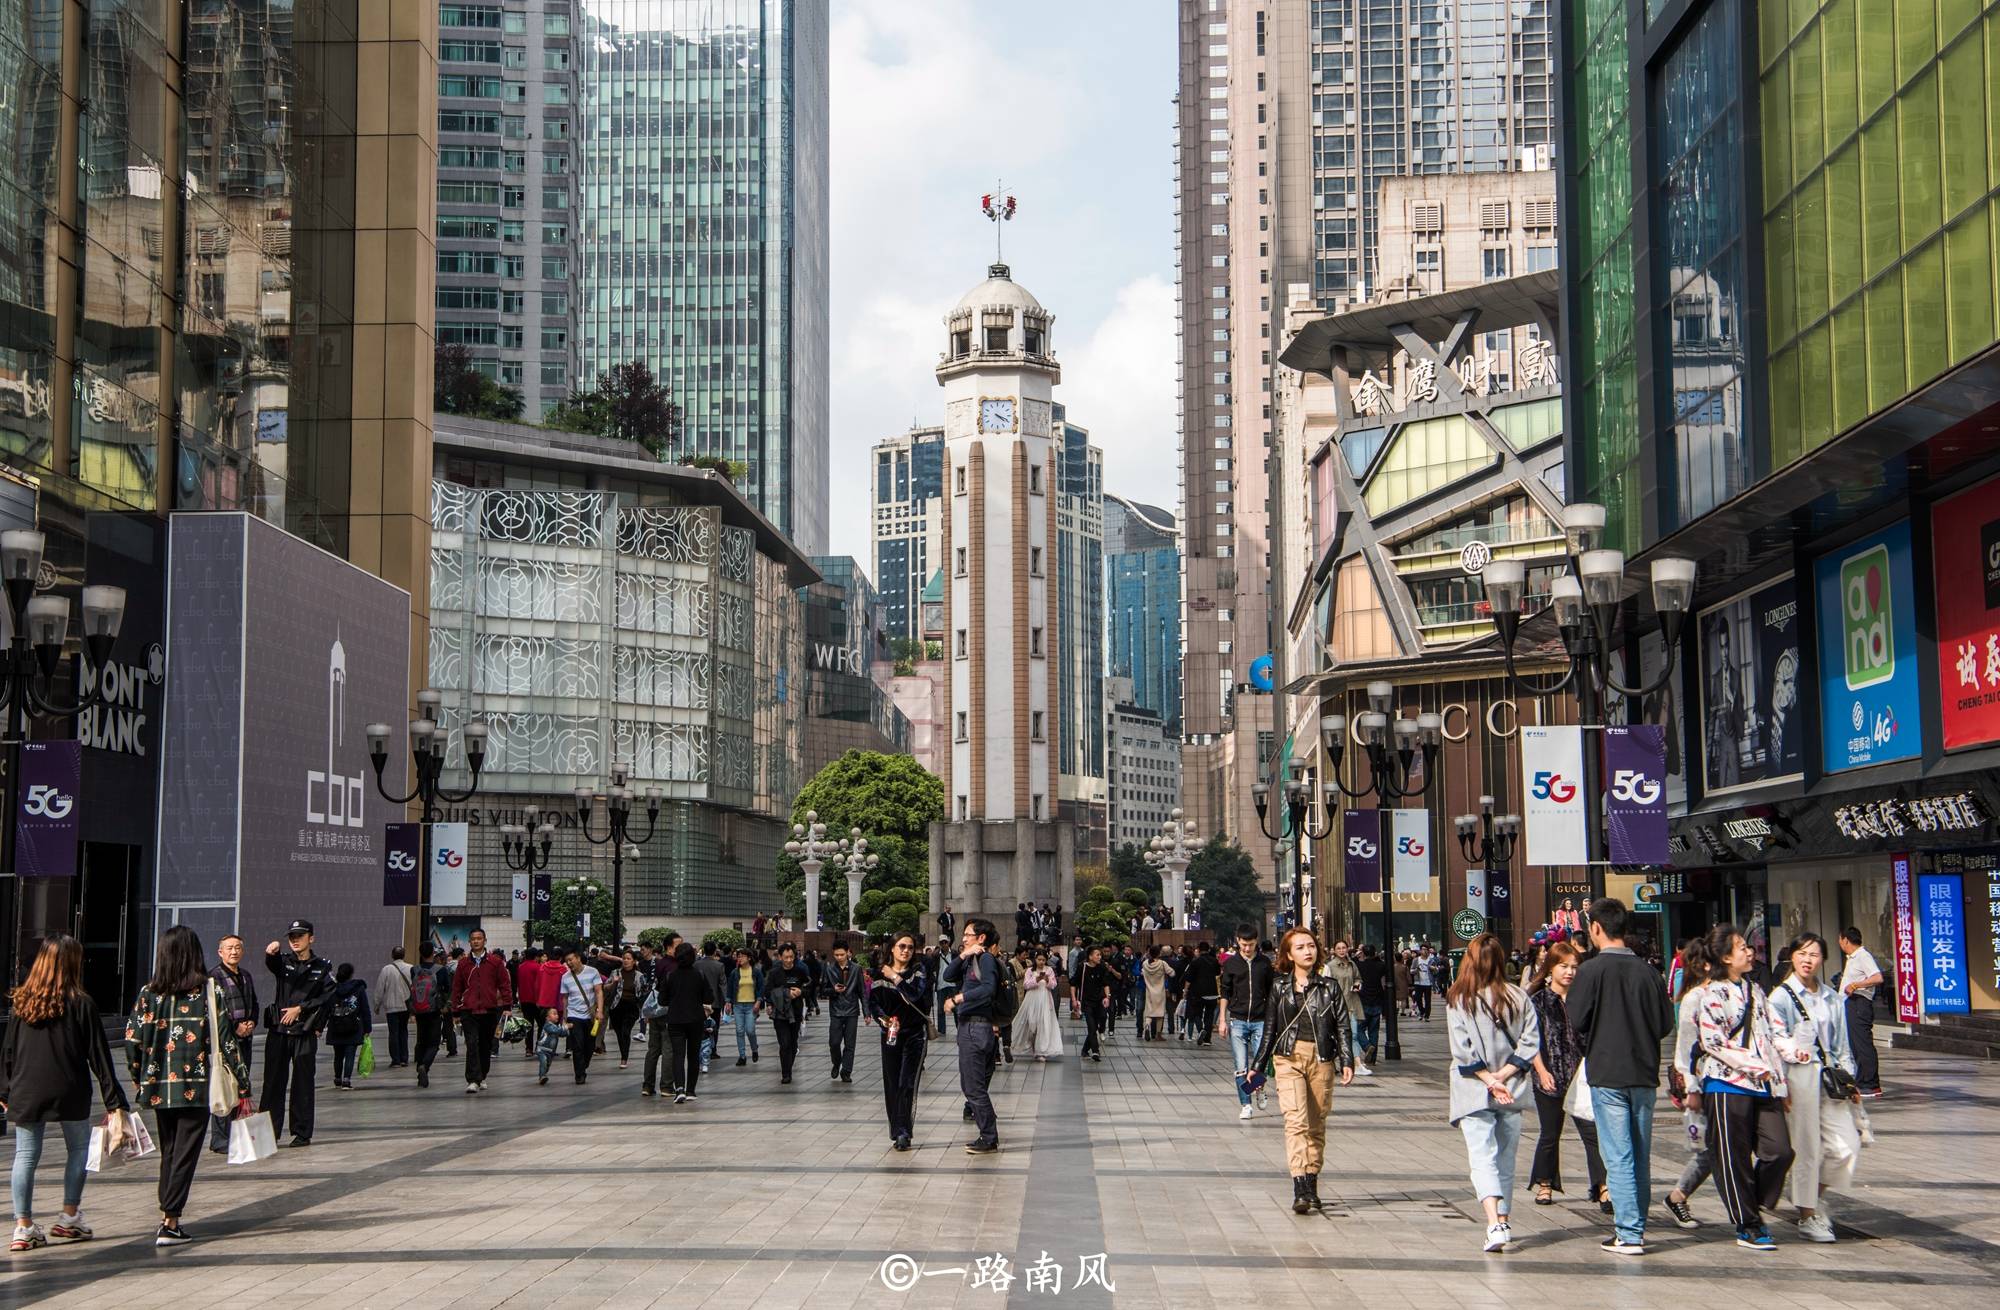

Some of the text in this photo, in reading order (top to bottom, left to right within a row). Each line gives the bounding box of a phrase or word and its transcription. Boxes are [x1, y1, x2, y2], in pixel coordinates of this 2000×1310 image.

[1352, 339, 1551, 413] 金鹰财富
[814, 642, 863, 677] WFC
[79, 652, 148, 710] MONT
[1957, 694, 1983, 711] CHENG
[77, 702, 147, 756] BLANC
[1873, 713, 1891, 747] 4G
[1847, 735, 1871, 755] 中国移动
[1532, 771, 1576, 803] 5G
[1612, 770, 1660, 805] 5G
[1643, 779, 1660, 787] hello
[24, 784, 73, 819] 5G
[1348, 837, 1377, 858] 5G
[1398, 837, 1425, 856] 5G
[387, 850, 416, 871] 5G
[437, 848, 463, 868] 5G
[514, 889, 527, 901] 5G
[536, 889, 550, 902] 5G
[1469, 885, 1482, 897] 5G
[1492, 885, 1508, 899] 5G
[1556, 885, 1592, 893] GUCCI
[1894, 860, 1916, 1002] 眼镜批发中心
[1929, 883, 1957, 991] 眼镜批发中心
